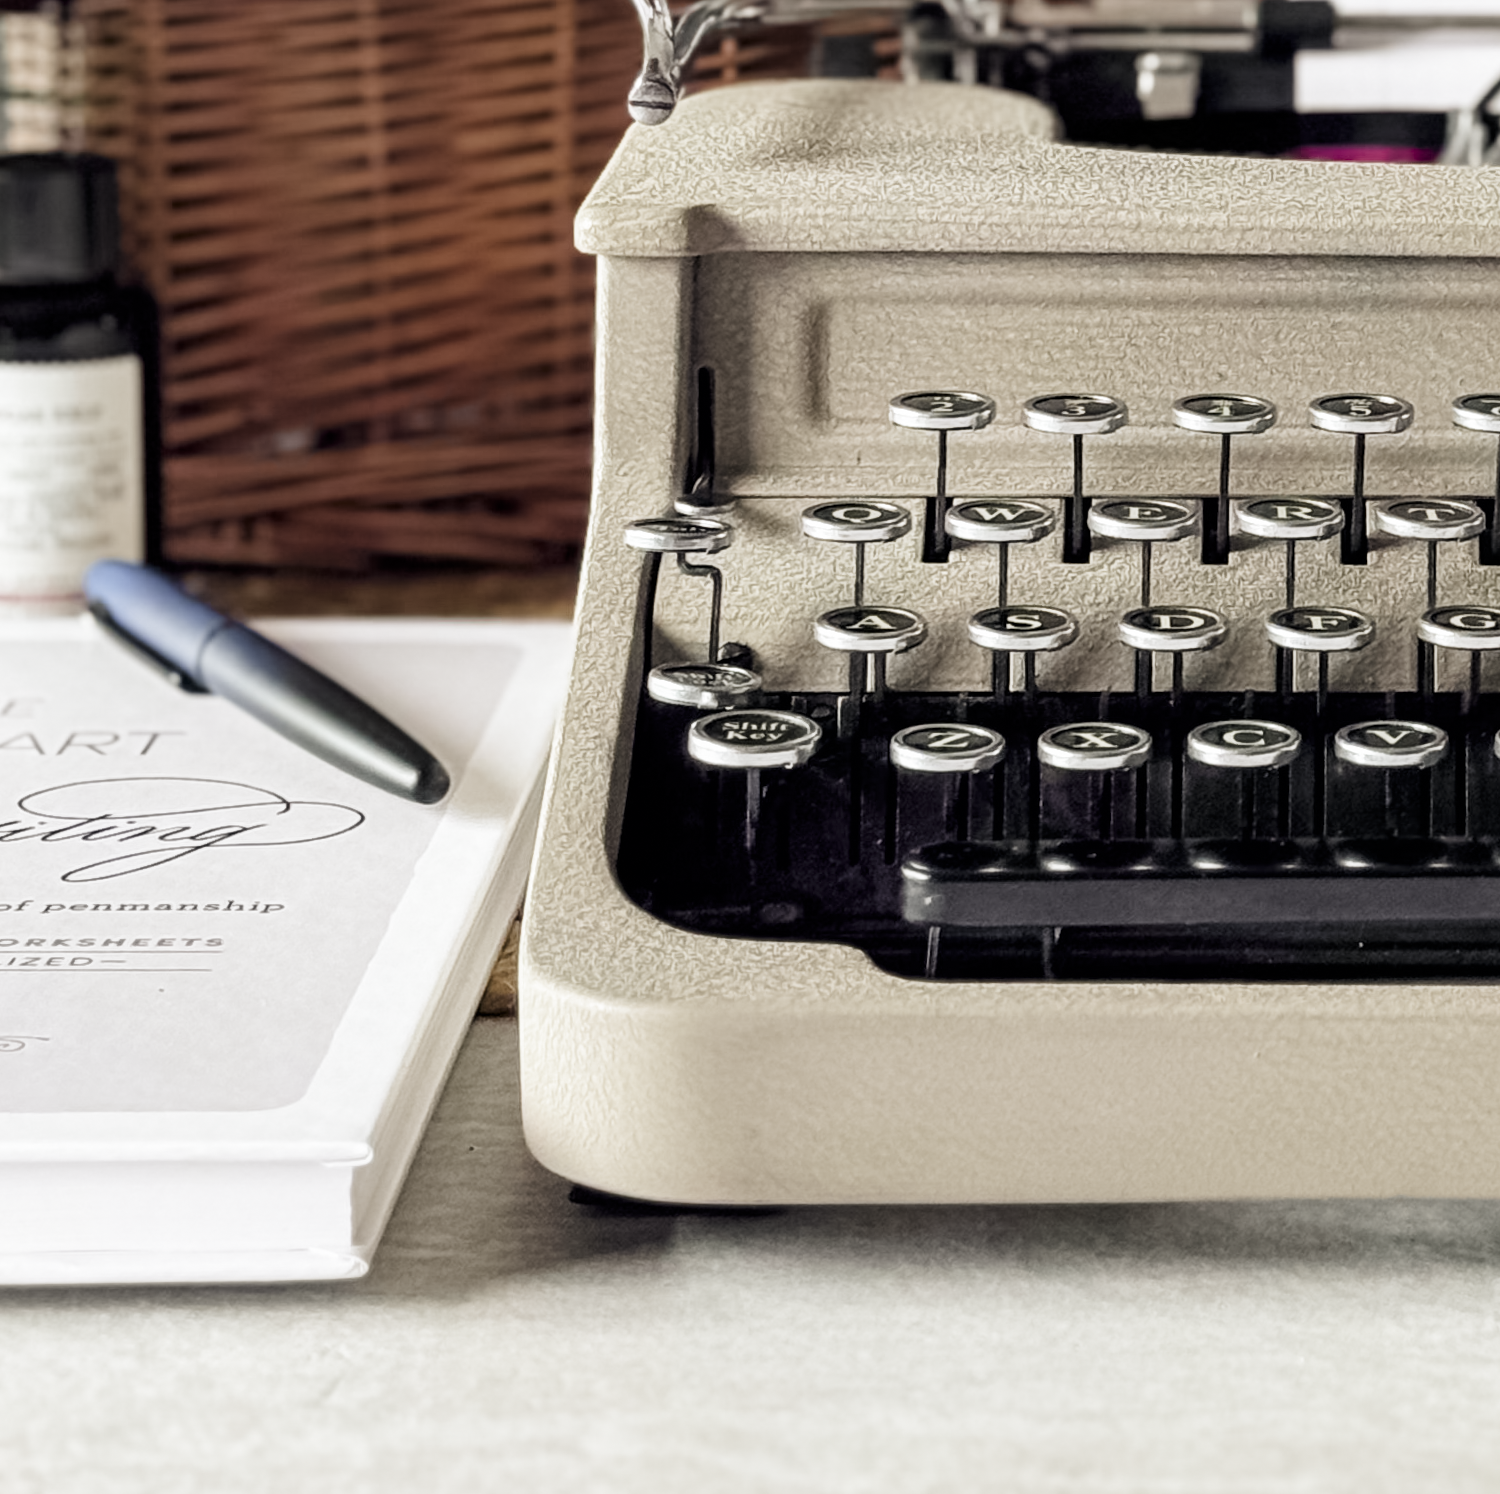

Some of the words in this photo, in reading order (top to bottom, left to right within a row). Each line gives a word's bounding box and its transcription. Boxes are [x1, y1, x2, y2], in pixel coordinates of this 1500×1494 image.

[930, 401, 954, 413] 2
[1061, 404, 1086, 416] 3
[1207, 403, 1234, 417] 4
[1349, 405, 1371, 417] 5
[832, 506, 882, 522] Q
[973, 507, 1027, 521] W
[1124, 506, 1167, 520] E
[1273, 505, 1317, 520] R
[1407, 508, 1456, 521] T
[846, 614, 898, 630] A
[1005, 614, 1042, 631] S
[1153, 614, 1205, 630] D
[1303, 614, 1348, 630] F
[1448, 613, 1497, 630] G
[722, 721, 789, 731] Shift
[0, 731, 187, 756] ART
[726, 730, 783, 742] Key
[927, 731, 970, 749] Z
[1073, 731, 1119, 749] X
[1221, 729, 1266, 746] C
[1366, 729, 1413, 746] V
[0, 899, 34, 912] of
[40, 899, 285, 914] penmanship
[0, 956, 93, 967] IZED
